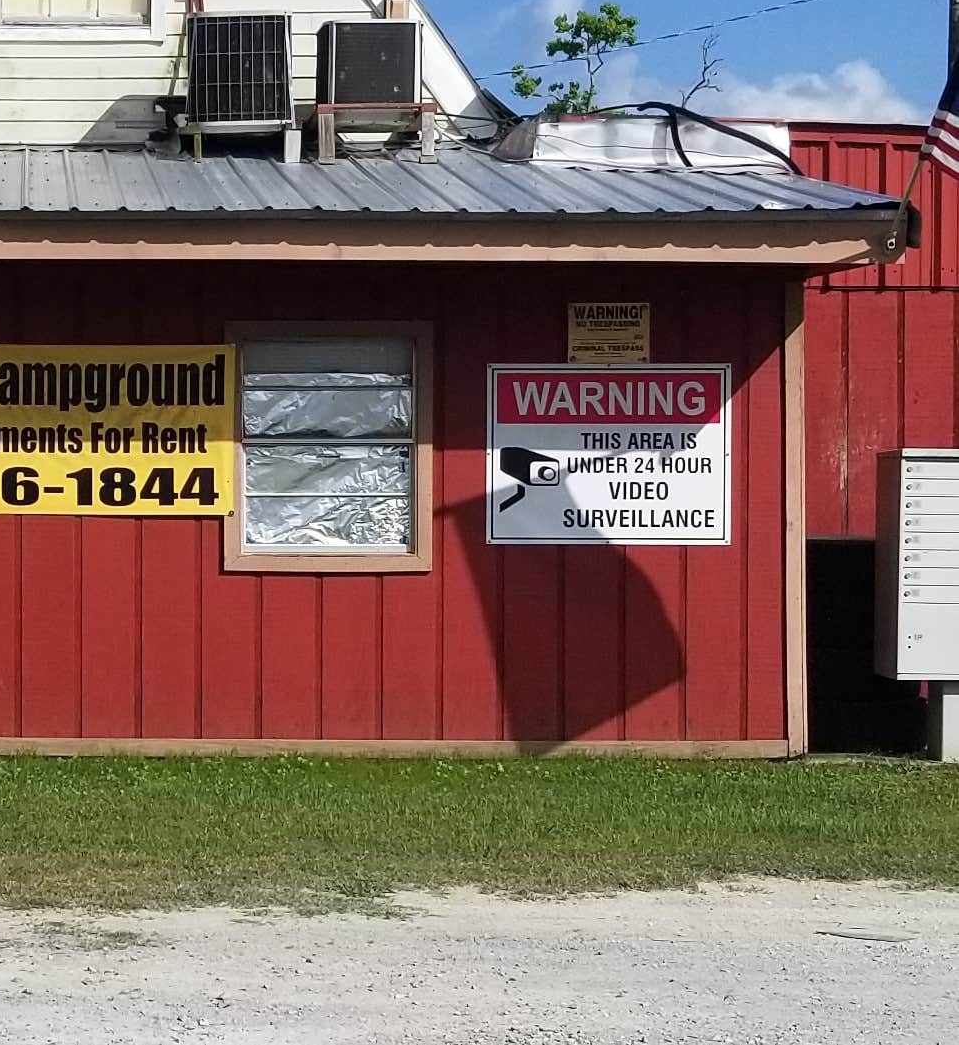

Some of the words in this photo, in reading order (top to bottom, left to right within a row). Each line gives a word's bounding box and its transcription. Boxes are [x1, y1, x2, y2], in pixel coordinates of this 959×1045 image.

[573, 305, 643, 320] WARNING!
[512, 381, 706, 416] WARNING
[91, 422, 135, 454] For
[142, 422, 207, 454] Rent
[580, 432, 621, 450] THIS
[627, 432, 675, 450] AREA
[680, 432, 697, 450] IS
[567, 457, 628, 474] UNDER
[634, 457, 655, 474] 24
[661, 457, 712, 474] HOUR
[609, 481, 669, 500] VIDEO
[562, 508, 715, 528] SURVEILLANCE
